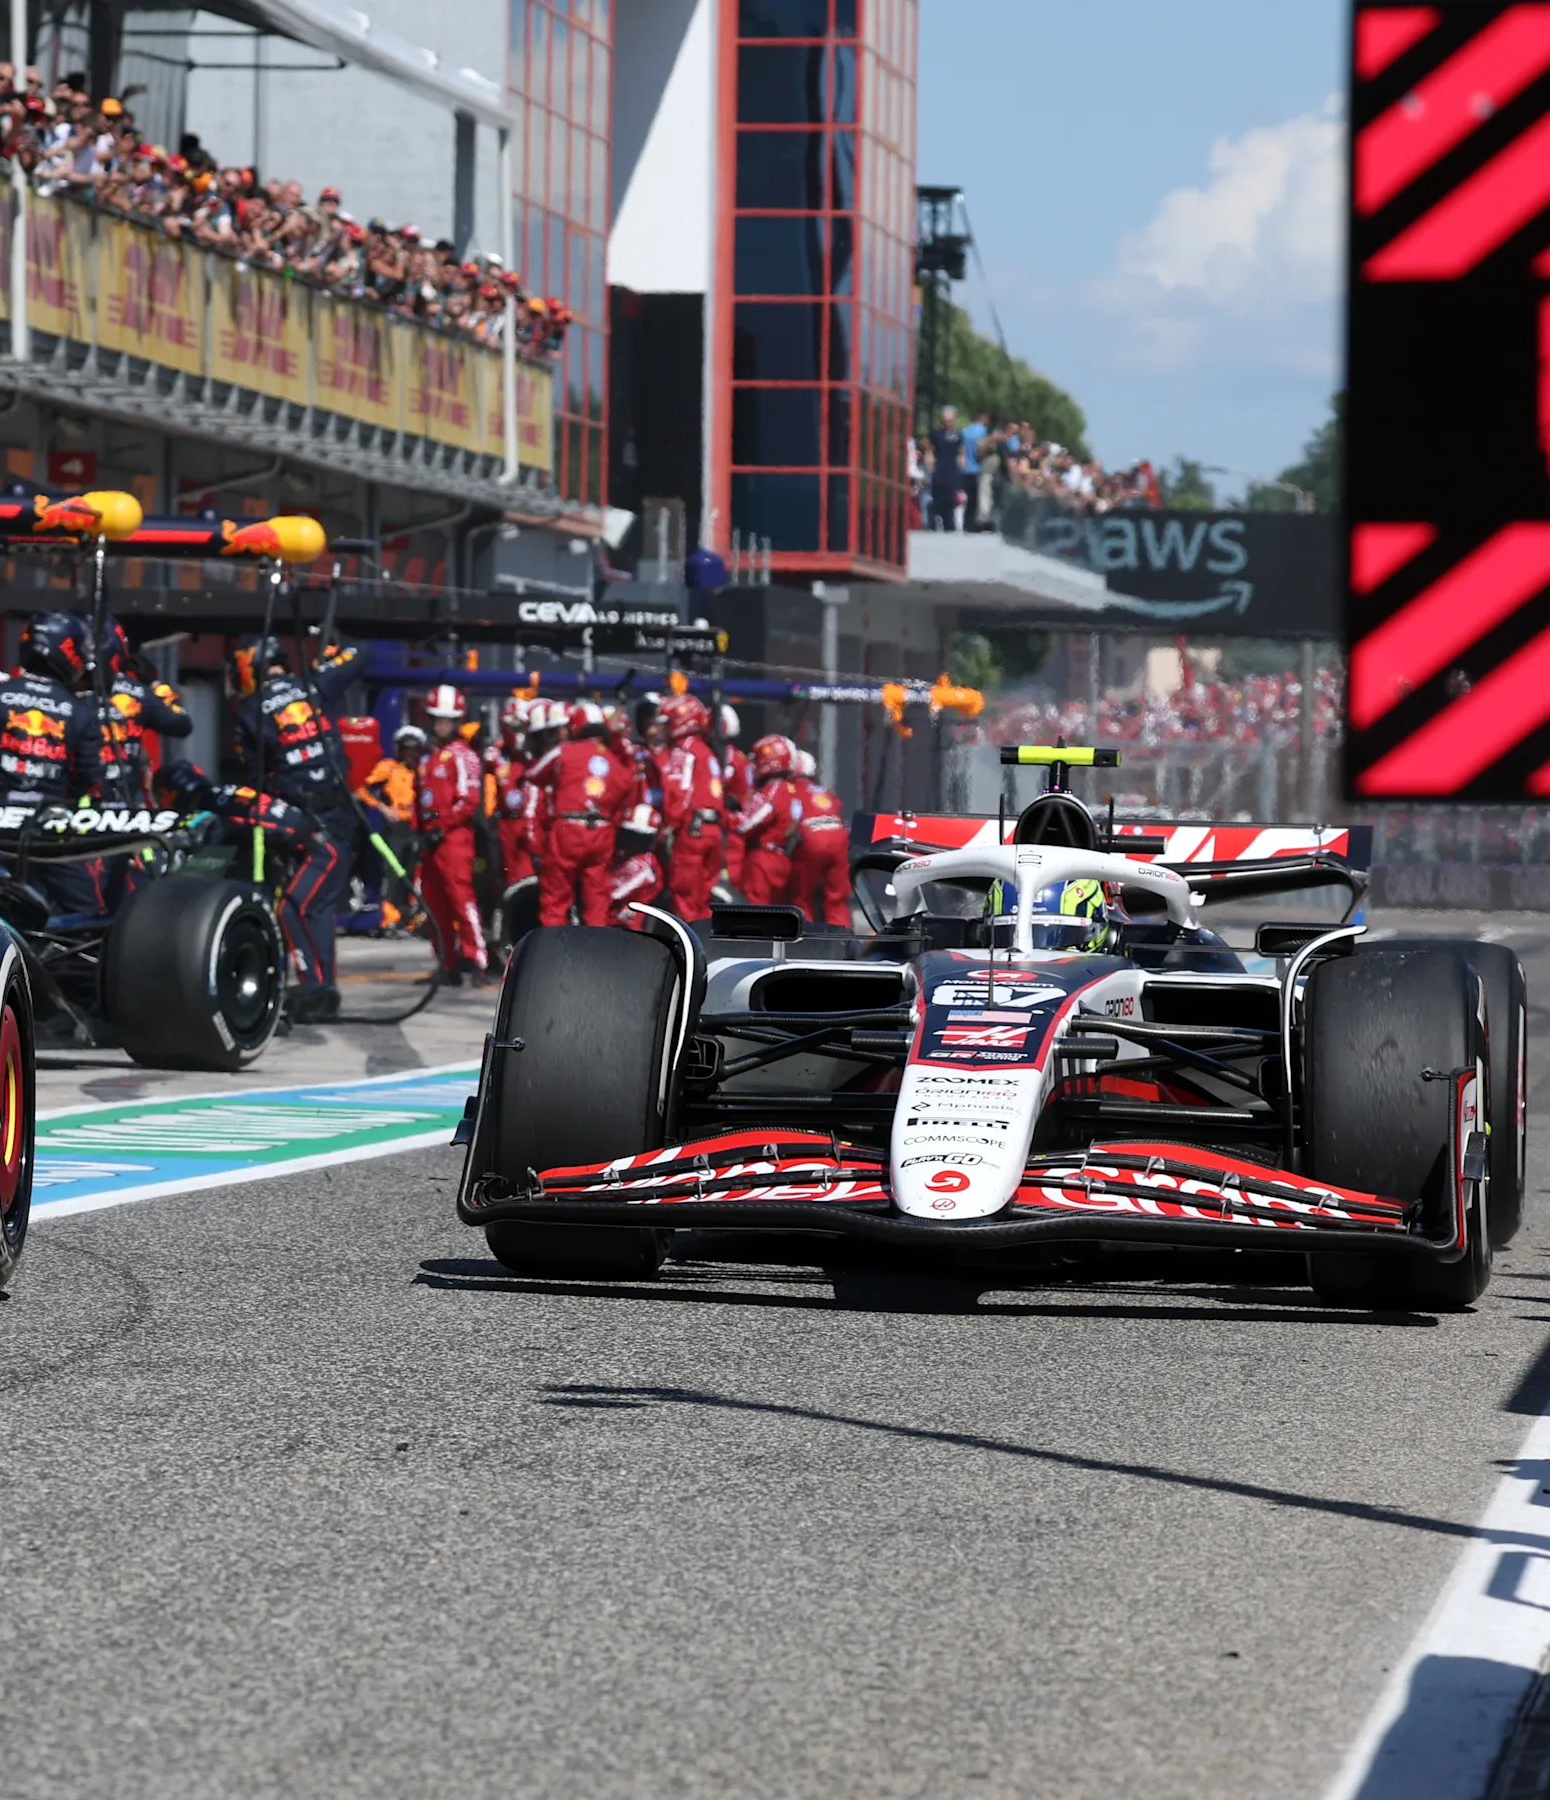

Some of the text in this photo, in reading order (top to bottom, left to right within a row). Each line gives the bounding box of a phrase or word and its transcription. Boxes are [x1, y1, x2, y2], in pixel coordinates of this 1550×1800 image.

[123, 245, 185, 343] DHL
[234, 281, 288, 374] DHL
[1101, 517, 1249, 574] aws
[0, 691, 73, 717] ORACLE
[1138, 866, 1180, 882] ORION180
[942, 979, 1055, 989] MoneyGram
[916, 1076, 1022, 1087] ZOOMEX
[937, 1102, 1015, 1112] Mphasis
[906, 1115, 1010, 1131] PIRELLI
[904, 1135, 1007, 1150] COMMSCOPE
[944, 1152, 983, 1166] GO
